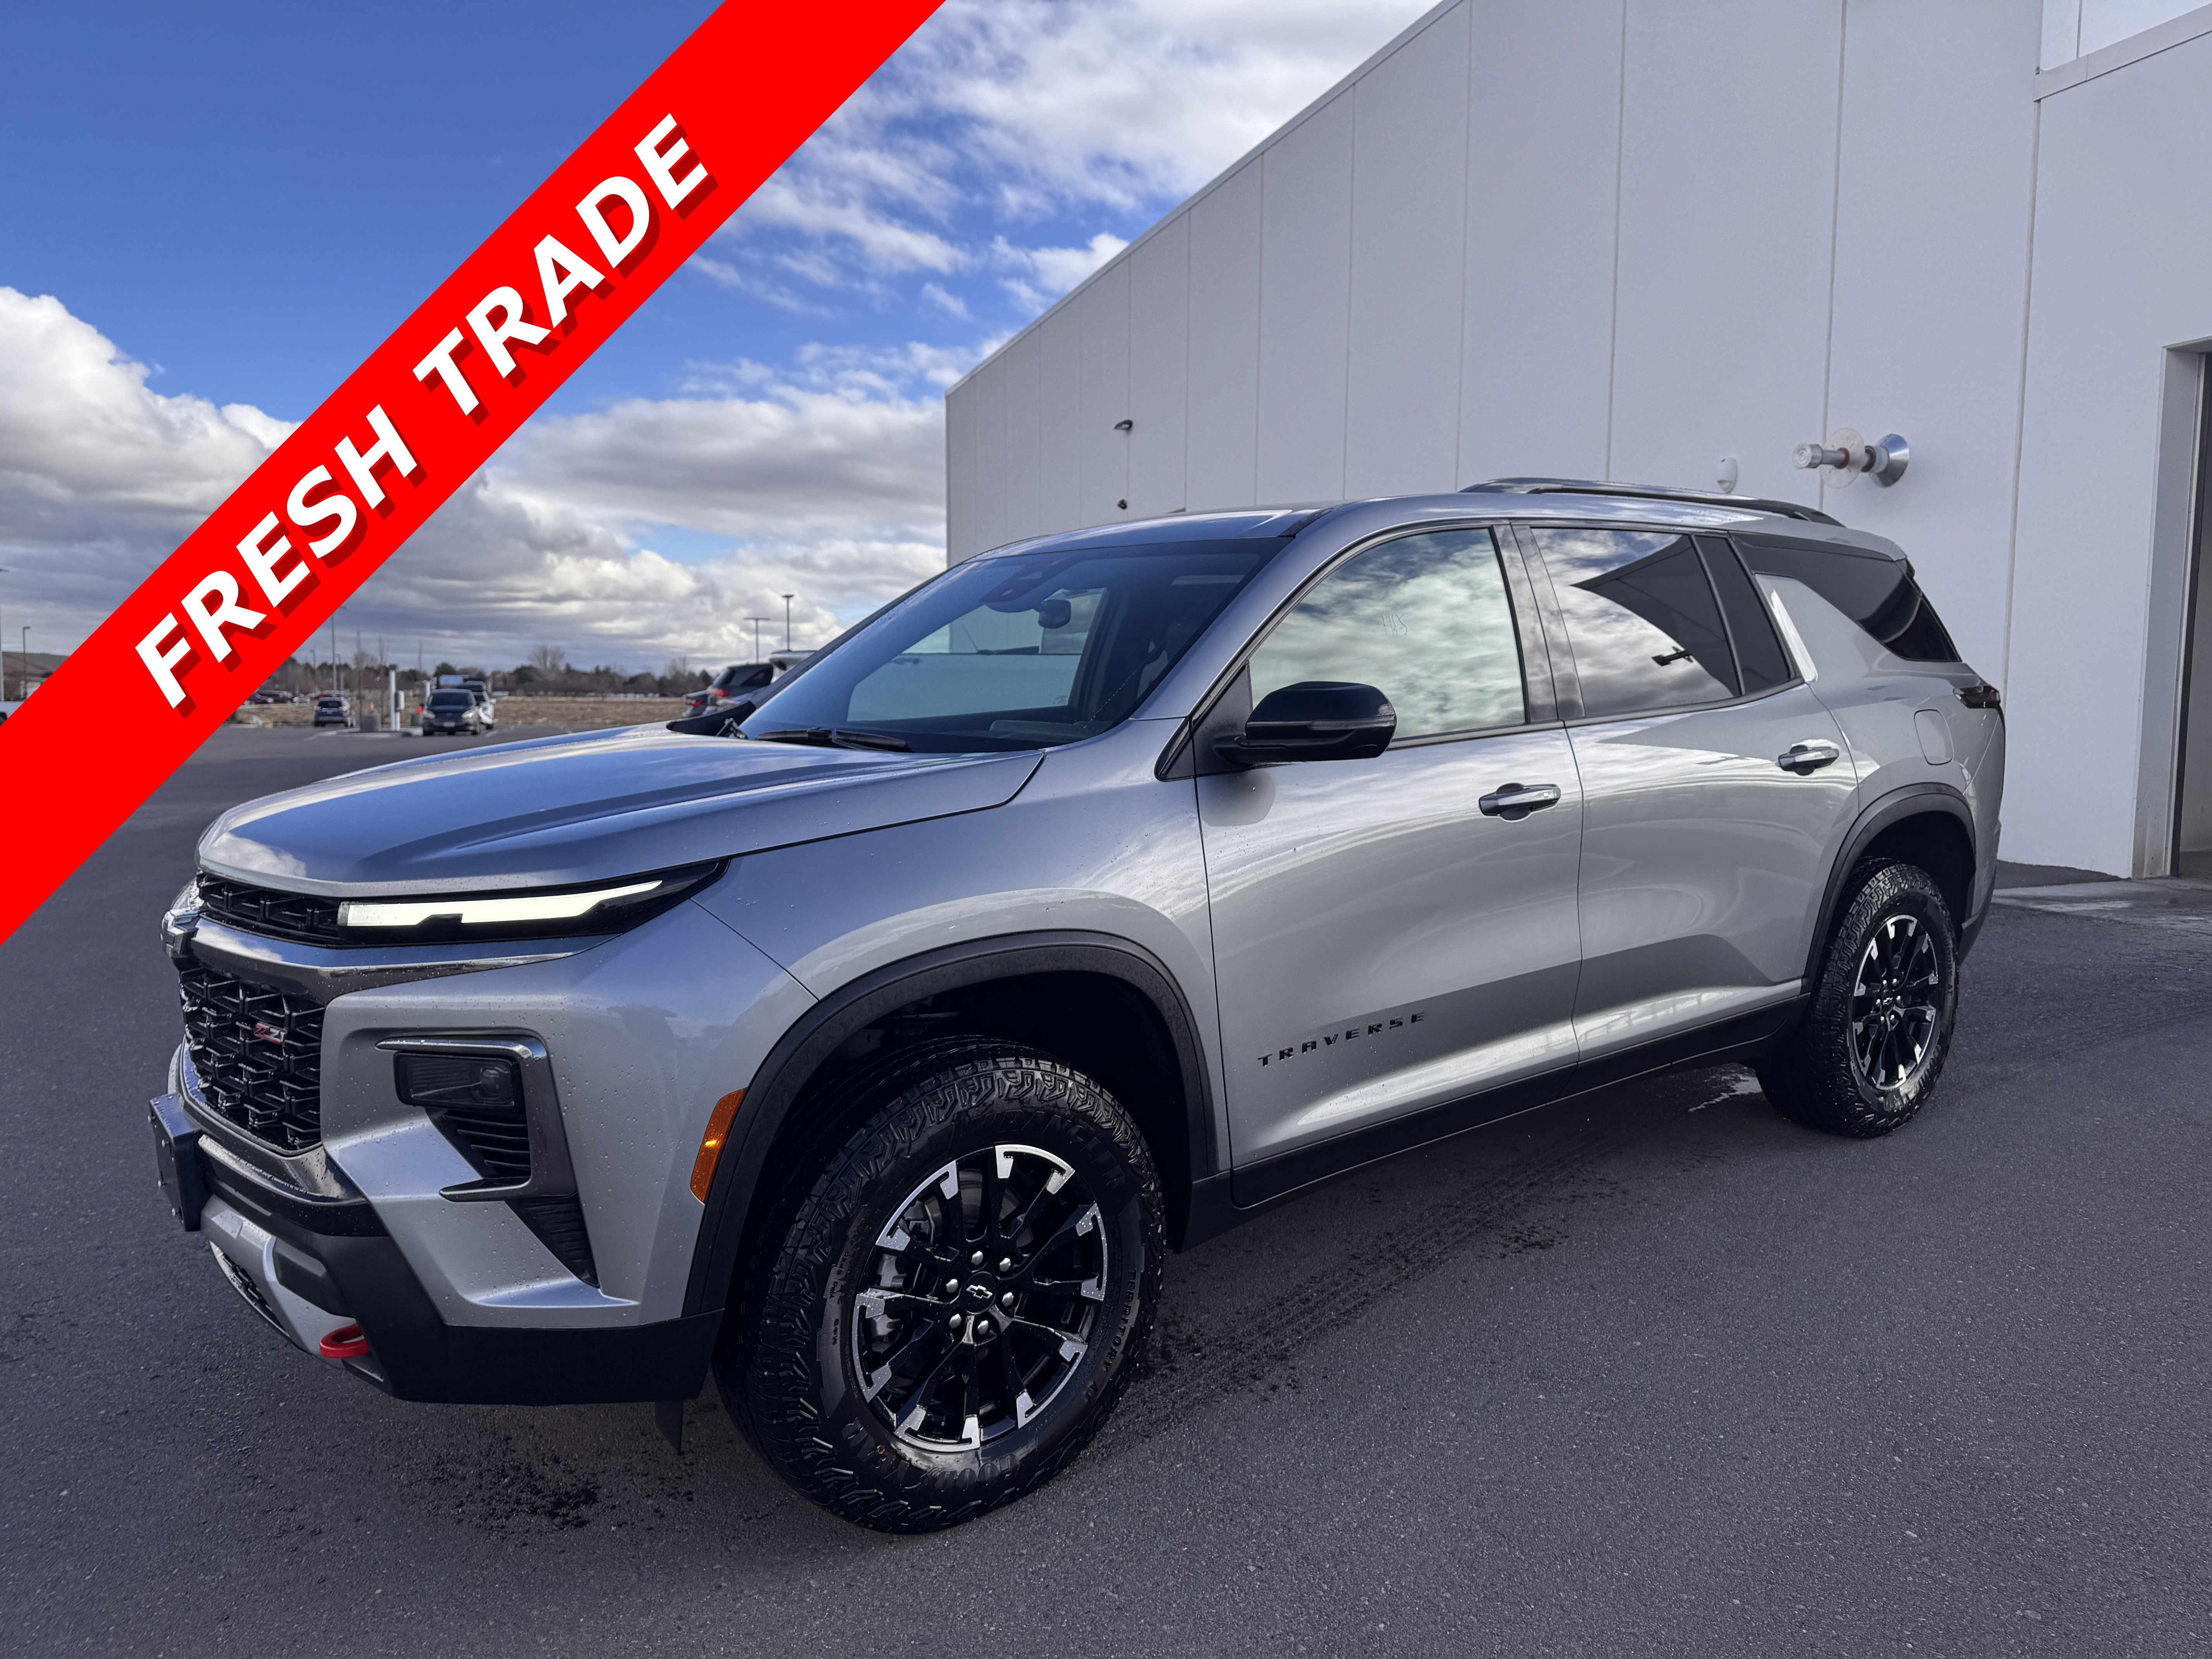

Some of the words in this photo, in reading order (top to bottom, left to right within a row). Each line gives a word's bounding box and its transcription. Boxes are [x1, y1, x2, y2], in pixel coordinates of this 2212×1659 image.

[254, 1022, 285, 1045] Z71
[1257, 1011, 1425, 1067] TRAVERSE
[971, 1109, 1126, 1188] WRANGLER
[1102, 1268, 1137, 1372] TERRITORY
[842, 1416, 1020, 1494] GOODYEAR
